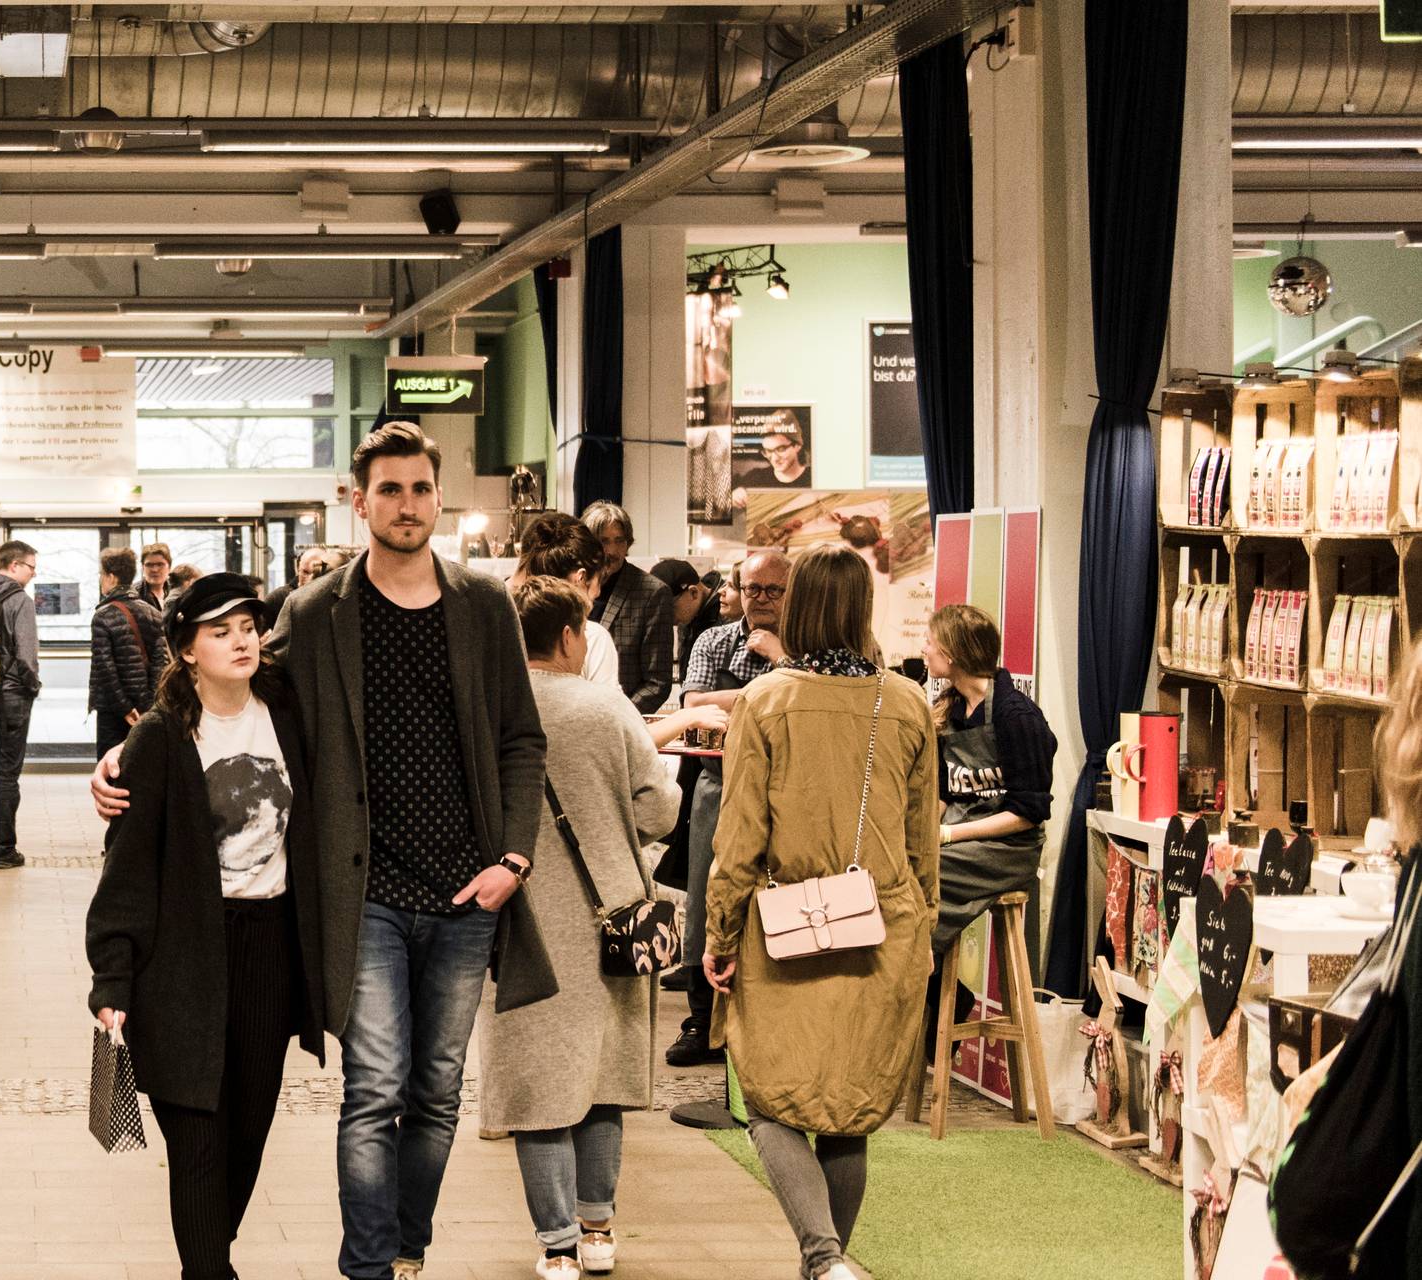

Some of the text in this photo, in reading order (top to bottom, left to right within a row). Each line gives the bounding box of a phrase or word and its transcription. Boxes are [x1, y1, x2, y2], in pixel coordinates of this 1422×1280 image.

[873, 354, 916, 367] Und we
[873, 369, 916, 382] bist du?
[394, 377, 456, 392] AUSGABE 1
[774, 423, 798, 434] wird.
[1206, 909, 1227, 932] Sieb
